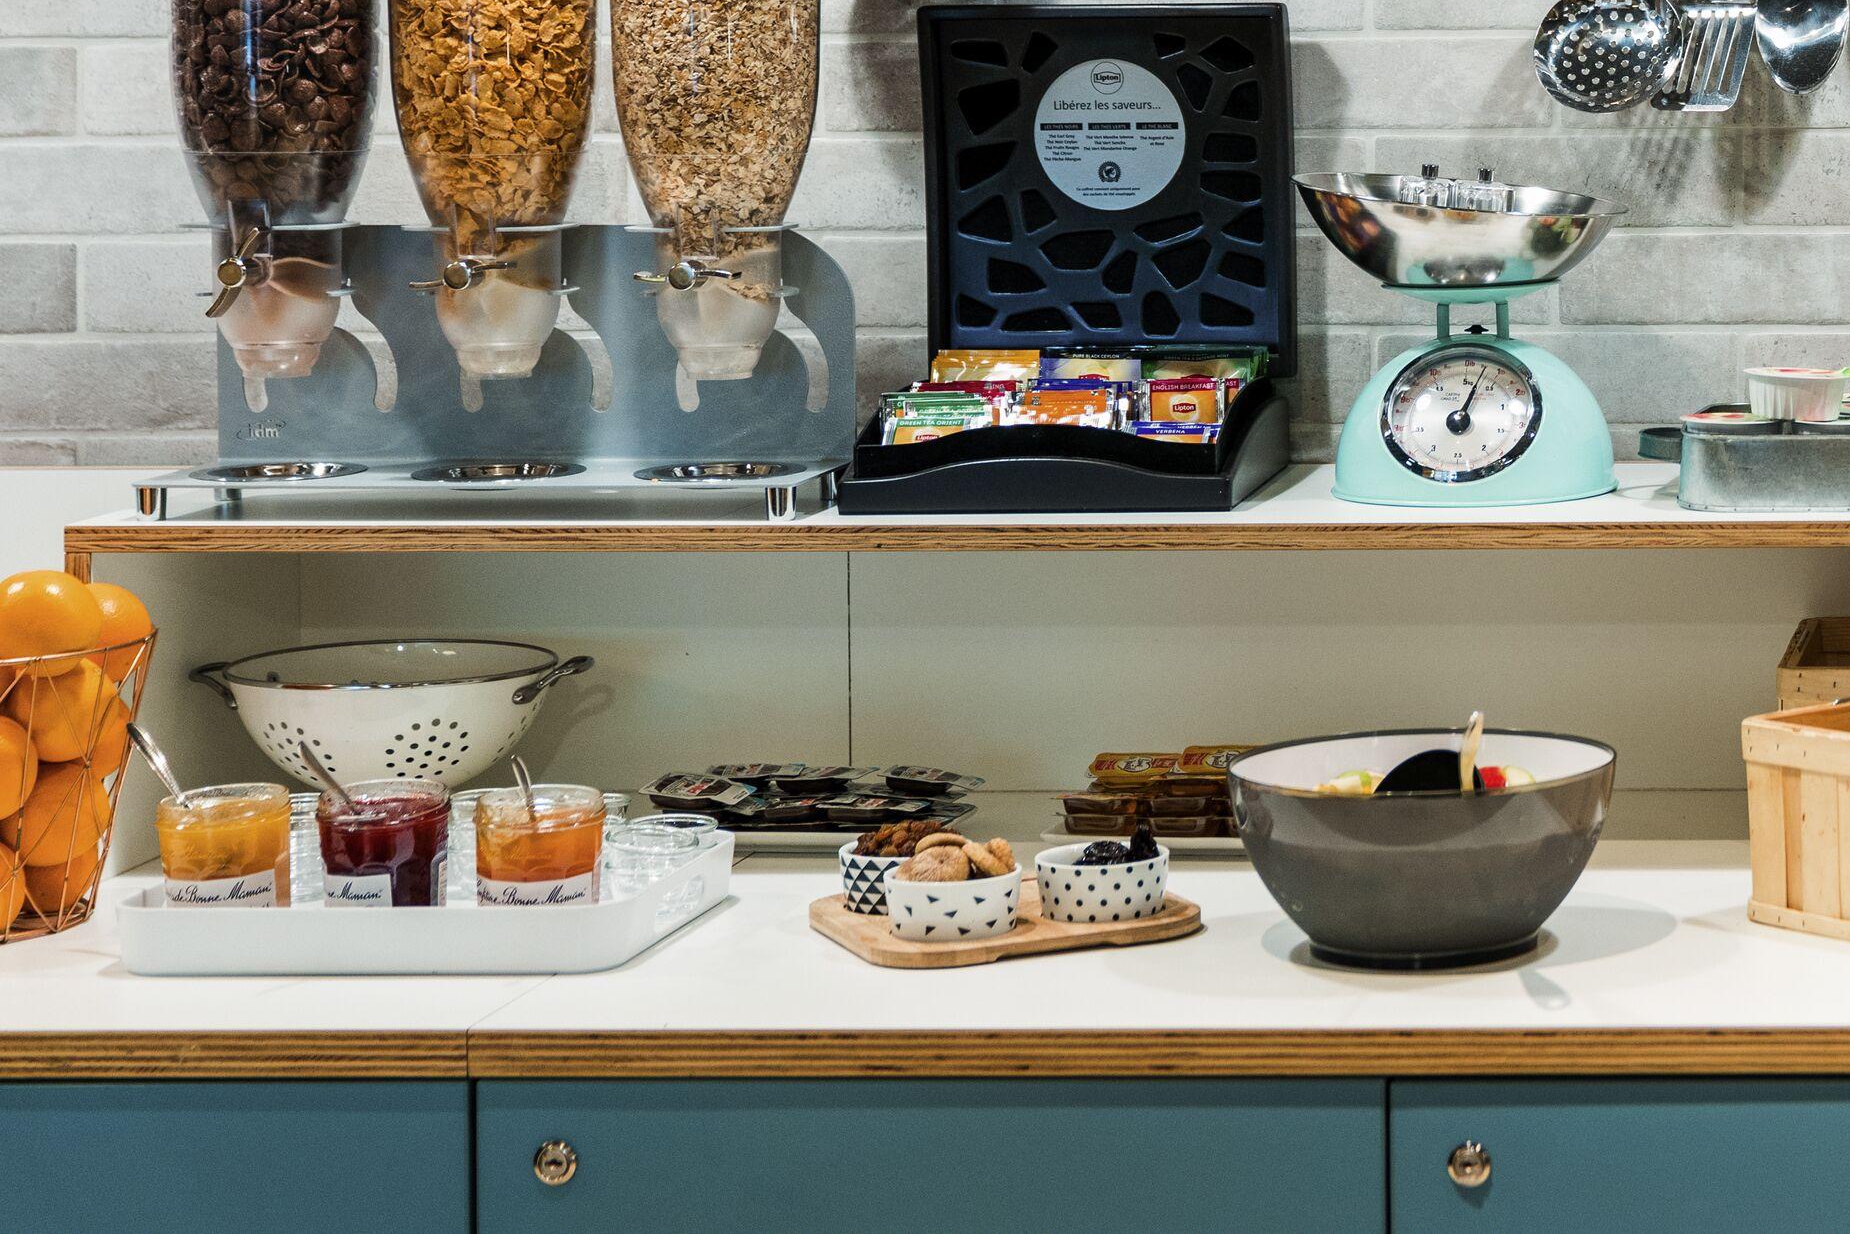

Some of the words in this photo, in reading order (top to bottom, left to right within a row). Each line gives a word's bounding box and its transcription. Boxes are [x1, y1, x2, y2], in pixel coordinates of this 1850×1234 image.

[1096, 74, 1118, 82] Lipton
[1054, 100, 1092, 110] Libérez
[1094, 100, 1110, 110] les
[1110, 101, 1161, 110] saveurs...
[1180, 382, 1215, 390] BREAKFAST
[1174, 404, 1194, 412] Lipton
[186, 884, 221, 903] Bonne
[224, 880, 272, 900] Maman
[336, 882, 382, 901] Maman
[502, 886, 540, 906] Bonne
[541, 884, 586, 904] Maman
